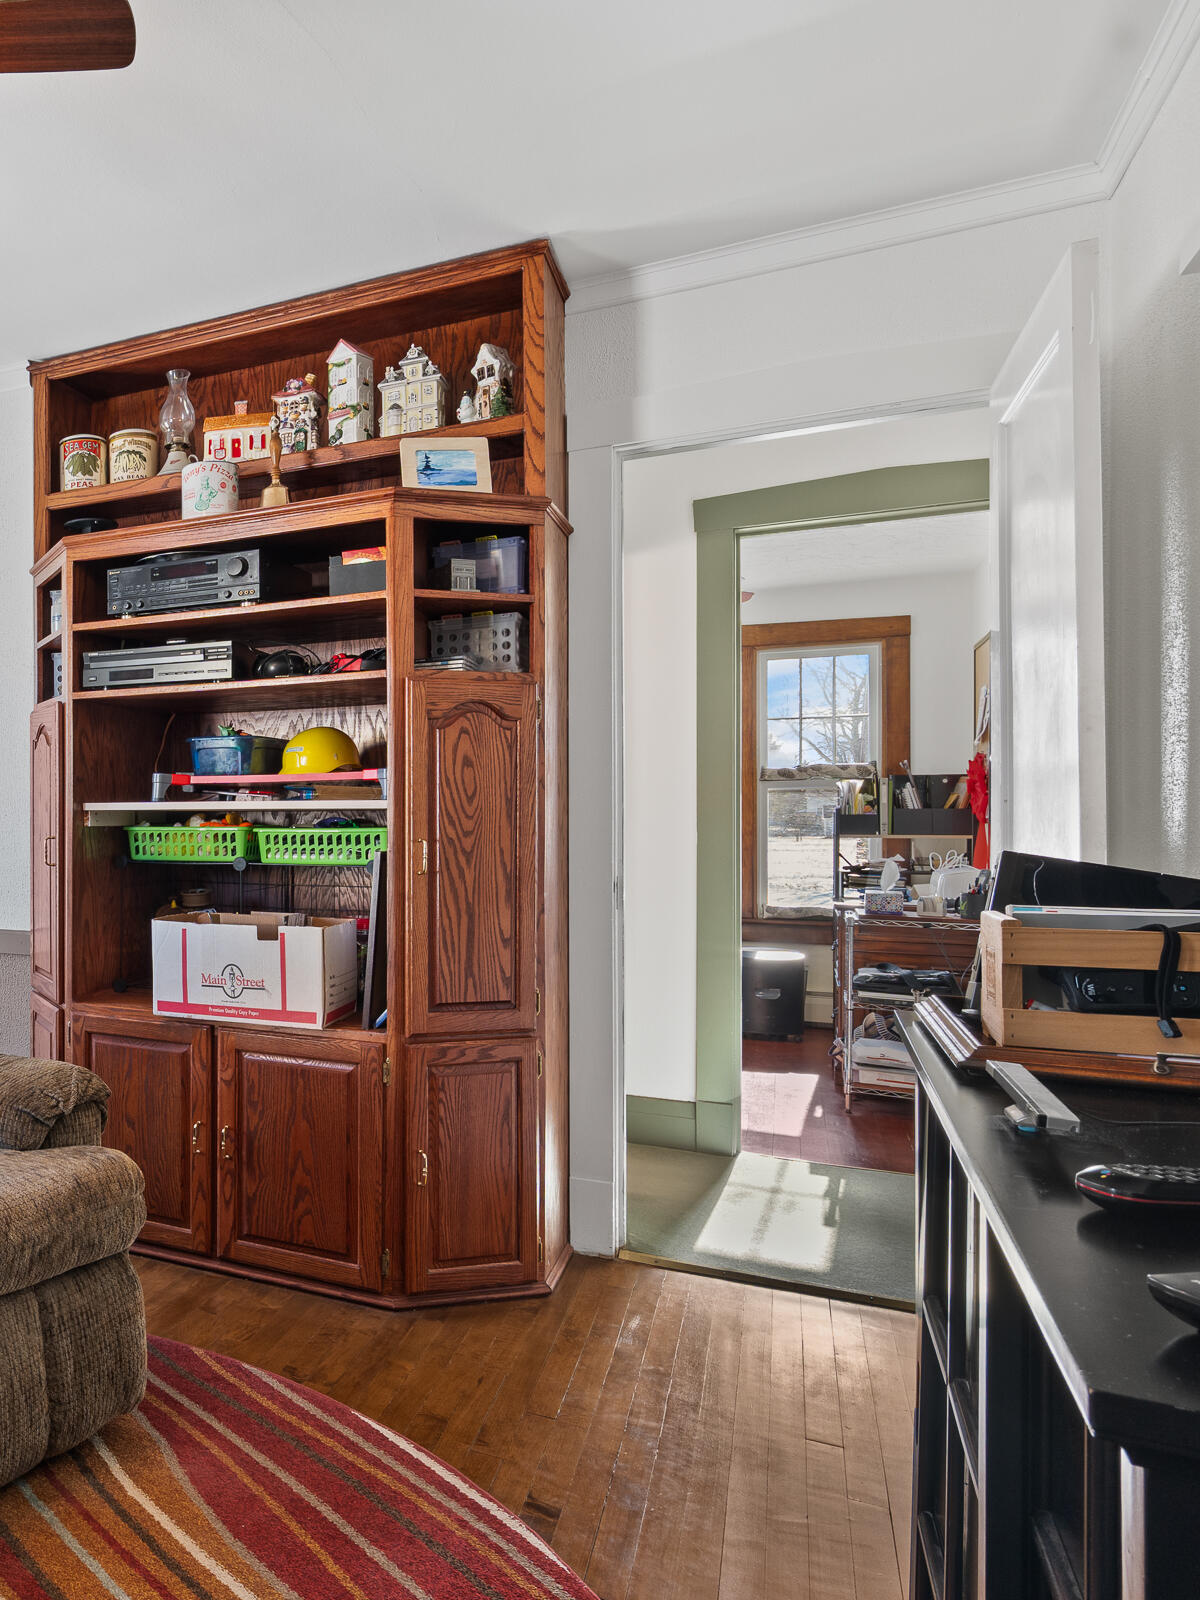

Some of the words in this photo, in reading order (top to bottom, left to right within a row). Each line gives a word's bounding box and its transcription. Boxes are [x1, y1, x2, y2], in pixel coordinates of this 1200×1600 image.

[64, 442, 79, 456] SEA
[82, 441, 99, 449] GEM
[210, 463, 234, 481] Pizza
[70, 480, 94, 488] PEAS
[201, 972, 227, 986] Main
[235, 974, 265, 988] Street
[224, 1008, 238, 1016] Quality
